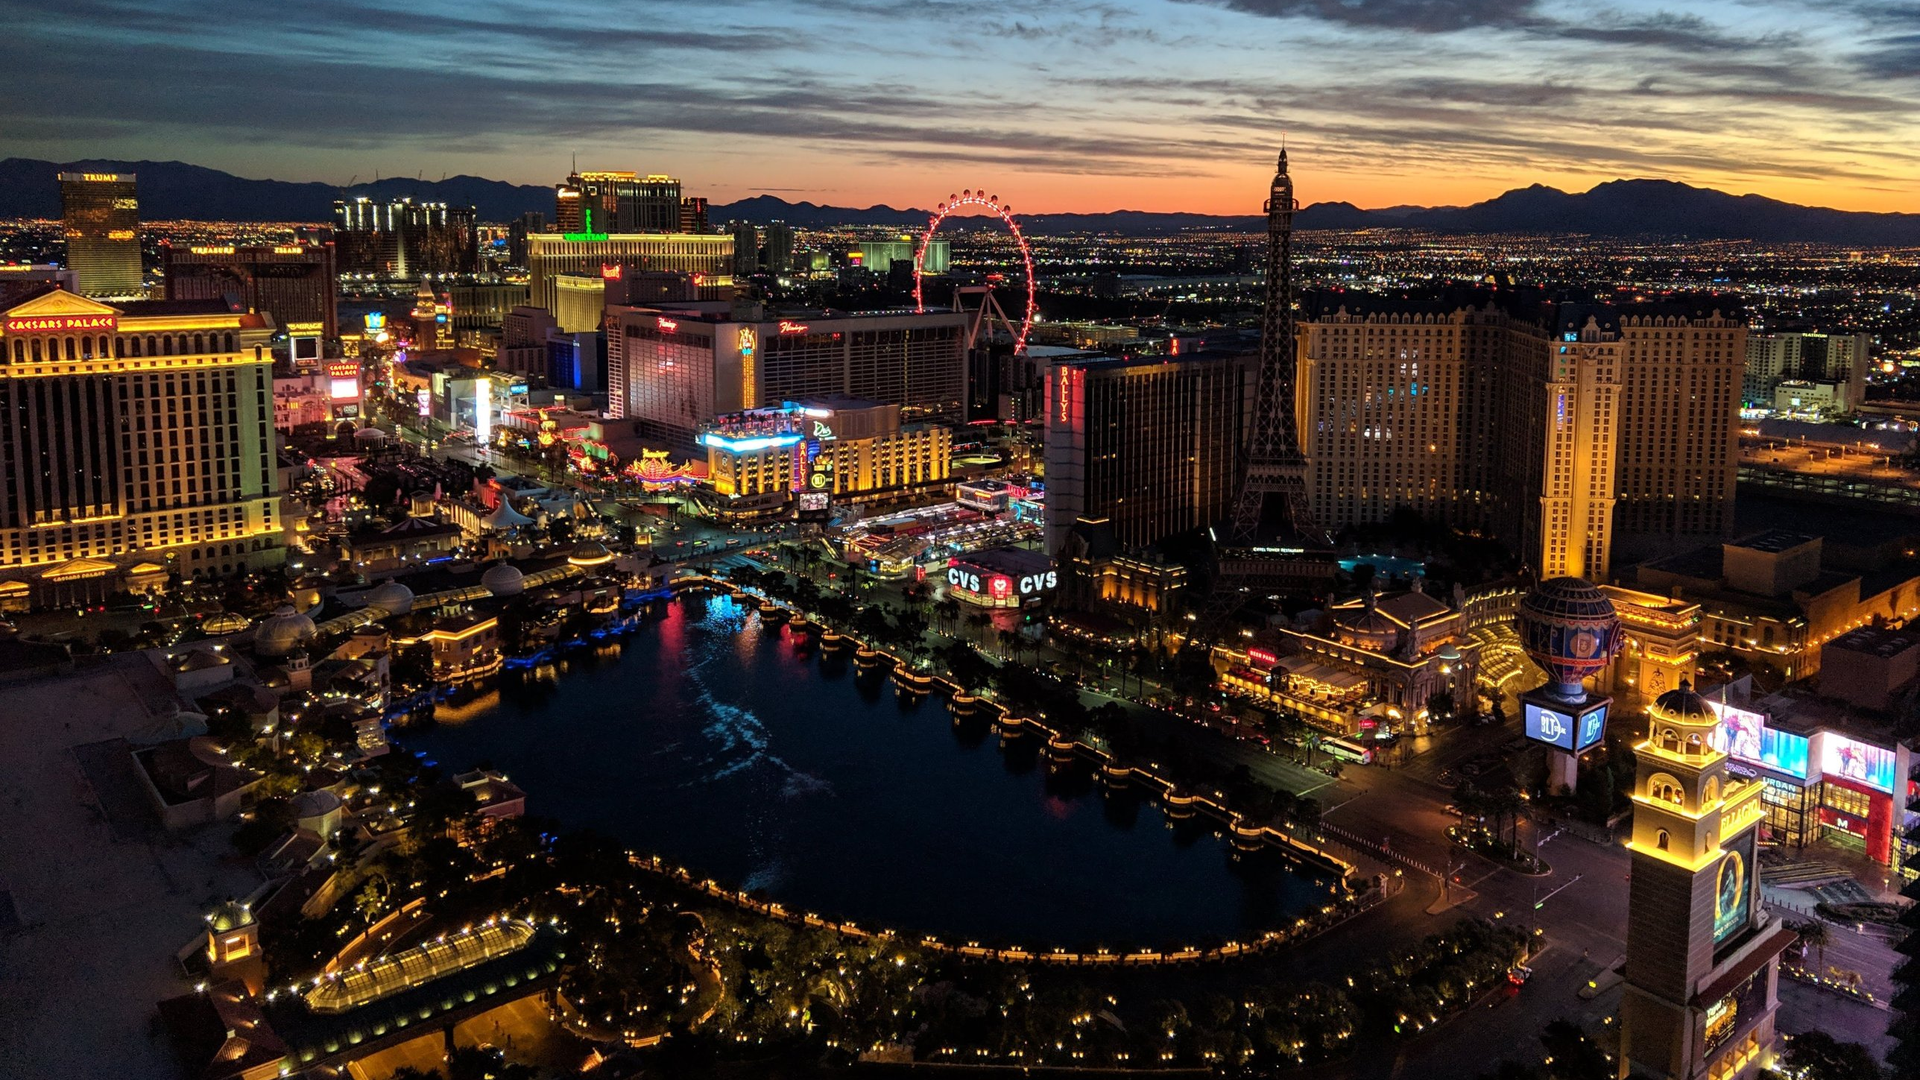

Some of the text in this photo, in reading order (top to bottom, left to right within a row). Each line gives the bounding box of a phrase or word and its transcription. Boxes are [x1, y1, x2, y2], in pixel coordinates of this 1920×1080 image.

[83, 173, 118, 181] TRUMP
[563, 232, 608, 241] VENETIAN
[191, 246, 303, 255] TREASURE ISLAND
[8, 318, 113, 330] CAESARS PALACE
[780, 321, 808, 334] Flamingo
[1060, 366, 1069, 422] BALLYS
[948, 567, 980, 593] CVS
[1020, 571, 1058, 594] CVS
[1540, 715, 1556, 736] BLT
[1763, 776, 1796, 793] URBAN
[1721, 798, 1759, 830] ELLAGIO
[1837, 817, 1849, 829] M
